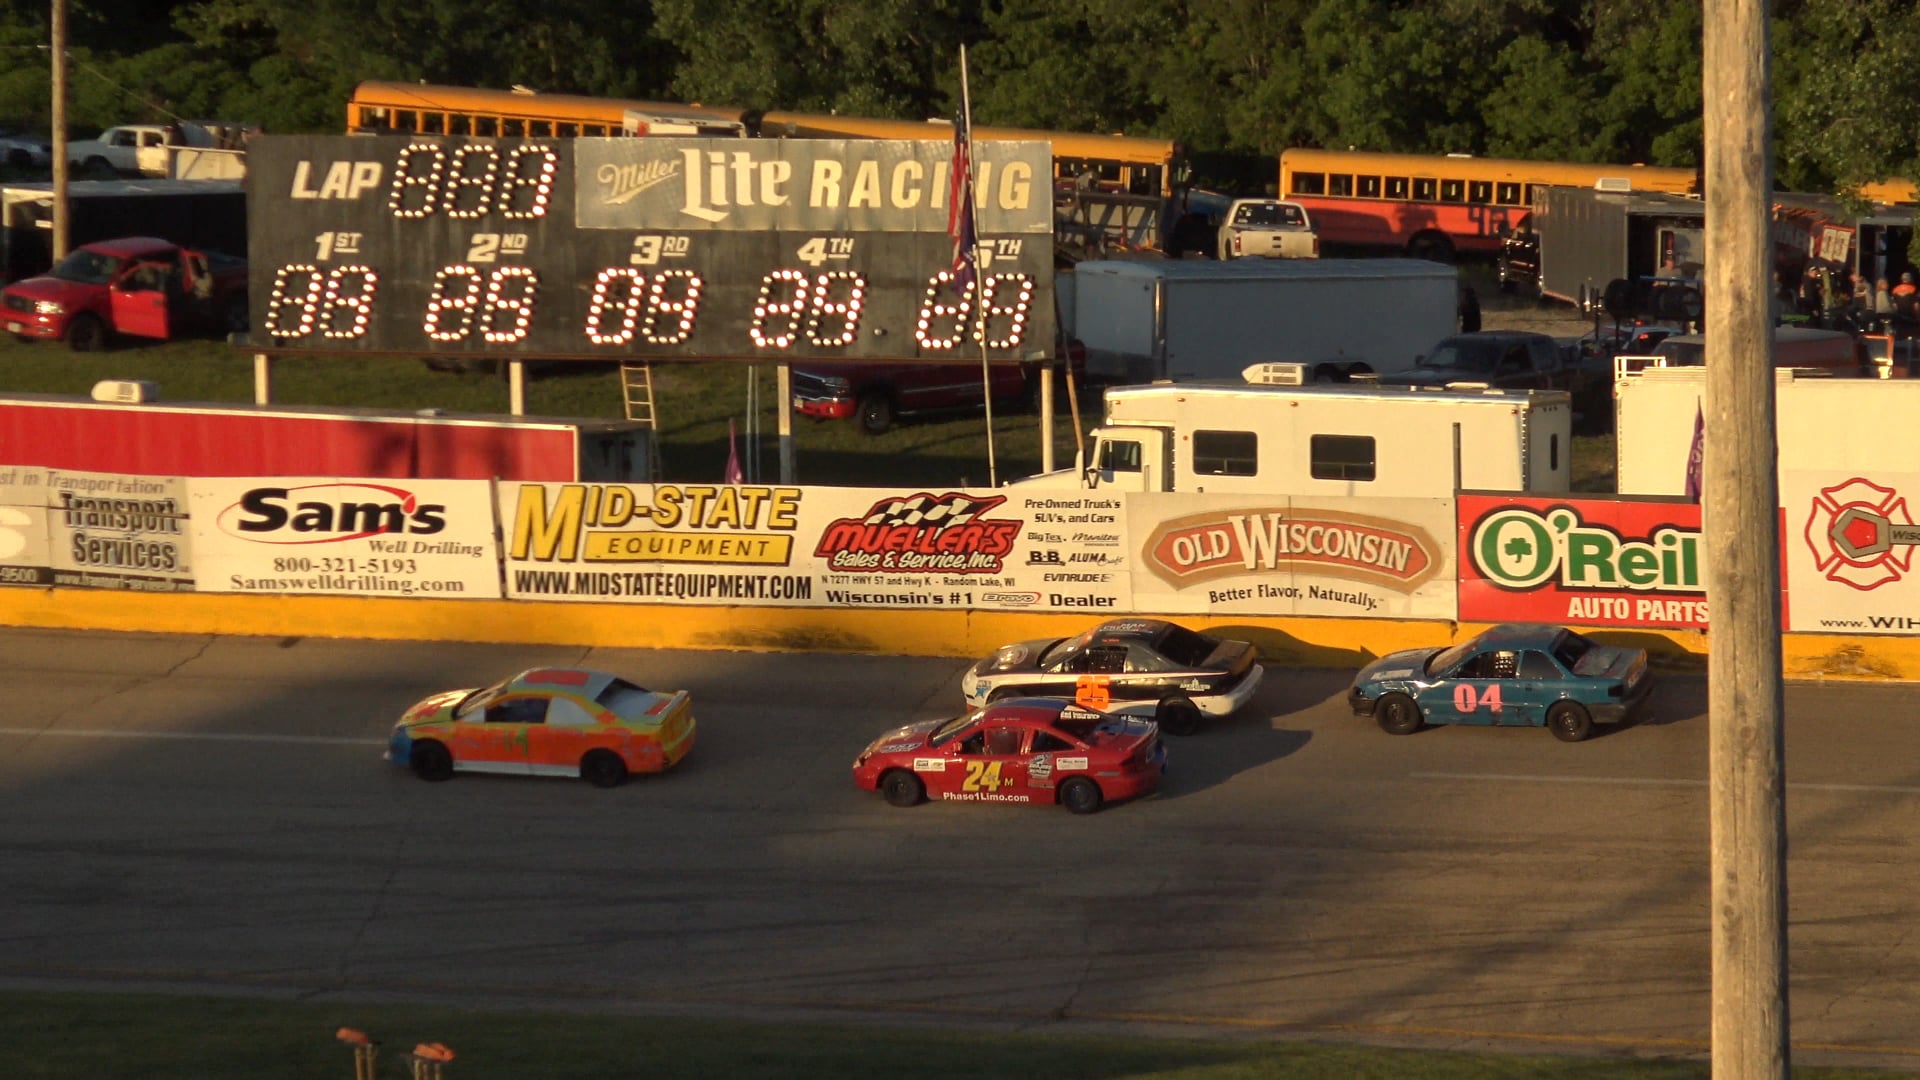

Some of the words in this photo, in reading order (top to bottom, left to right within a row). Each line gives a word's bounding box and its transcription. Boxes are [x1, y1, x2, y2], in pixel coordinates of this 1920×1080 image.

[291, 161, 383, 199] LAP
[598, 157, 682, 205] Miller
[679, 148, 791, 222] Lite
[315, 231, 363, 260] 1ST
[467, 233, 529, 262] 2ND
[630, 235, 690, 265] 3RD
[797, 238, 855, 267] 4TH
[58, 490, 182, 535] Transport
[237, 487, 447, 536] Sam's
[1025, 499, 1080, 509] Pre-Owned
[1083, 499, 1121, 509] Truck's
[1068, 514, 1089, 523] and
[1091, 514, 1115, 523] Cars
[511, 484, 803, 563] MID-STATE
[72, 530, 178, 572] Services
[369, 540, 406, 555] Well
[412, 542, 483, 559] Drilling
[608, 537, 770, 558] EQUIPMENT
[821, 523, 1018, 558] MUELLER'S
[1172, 530, 1231, 567] OLD
[1228, 513, 1413, 572] WISCONSIN
[1480, 513, 1700, 586] O'Reil
[273, 556, 417, 575] 800-321-5193
[833, 549, 881, 568] Sales
[883, 550, 896, 568] &
[230, 574, 464, 595] Samswelldrilling.com
[514, 570, 812, 600] WWW.MIDSTATEEQUIPMENT.COM
[821, 575, 828, 584] N
[830, 575, 850, 585] 7277
[852, 576, 872, 585] HWY
[887, 576, 902, 586] and
[904, 576, 922, 587] Hwy
[924, 577, 931, 586] K
[943, 577, 978, 587] Random
[980, 577, 1002, 588] Lake,
[1005, 579, 1015, 588] WI
[1043, 573, 1100, 583] EVINRUDE
[826, 590, 944, 605] Wisconsin's
[1049, 593, 1117, 607] Dealer
[1209, 586, 1252, 604] Better
[1258, 584, 1304, 600] Flavor,
[1309, 586, 1378, 610] Naturally.
[1567, 597, 1630, 620] AUTO
[1636, 599, 1710, 623] PARTS
[1453, 684, 1503, 713] 04
[962, 760, 1003, 792] 24
[1004, 778, 1014, 786] M
[942, 791, 1029, 802] Phase1Limo.com
